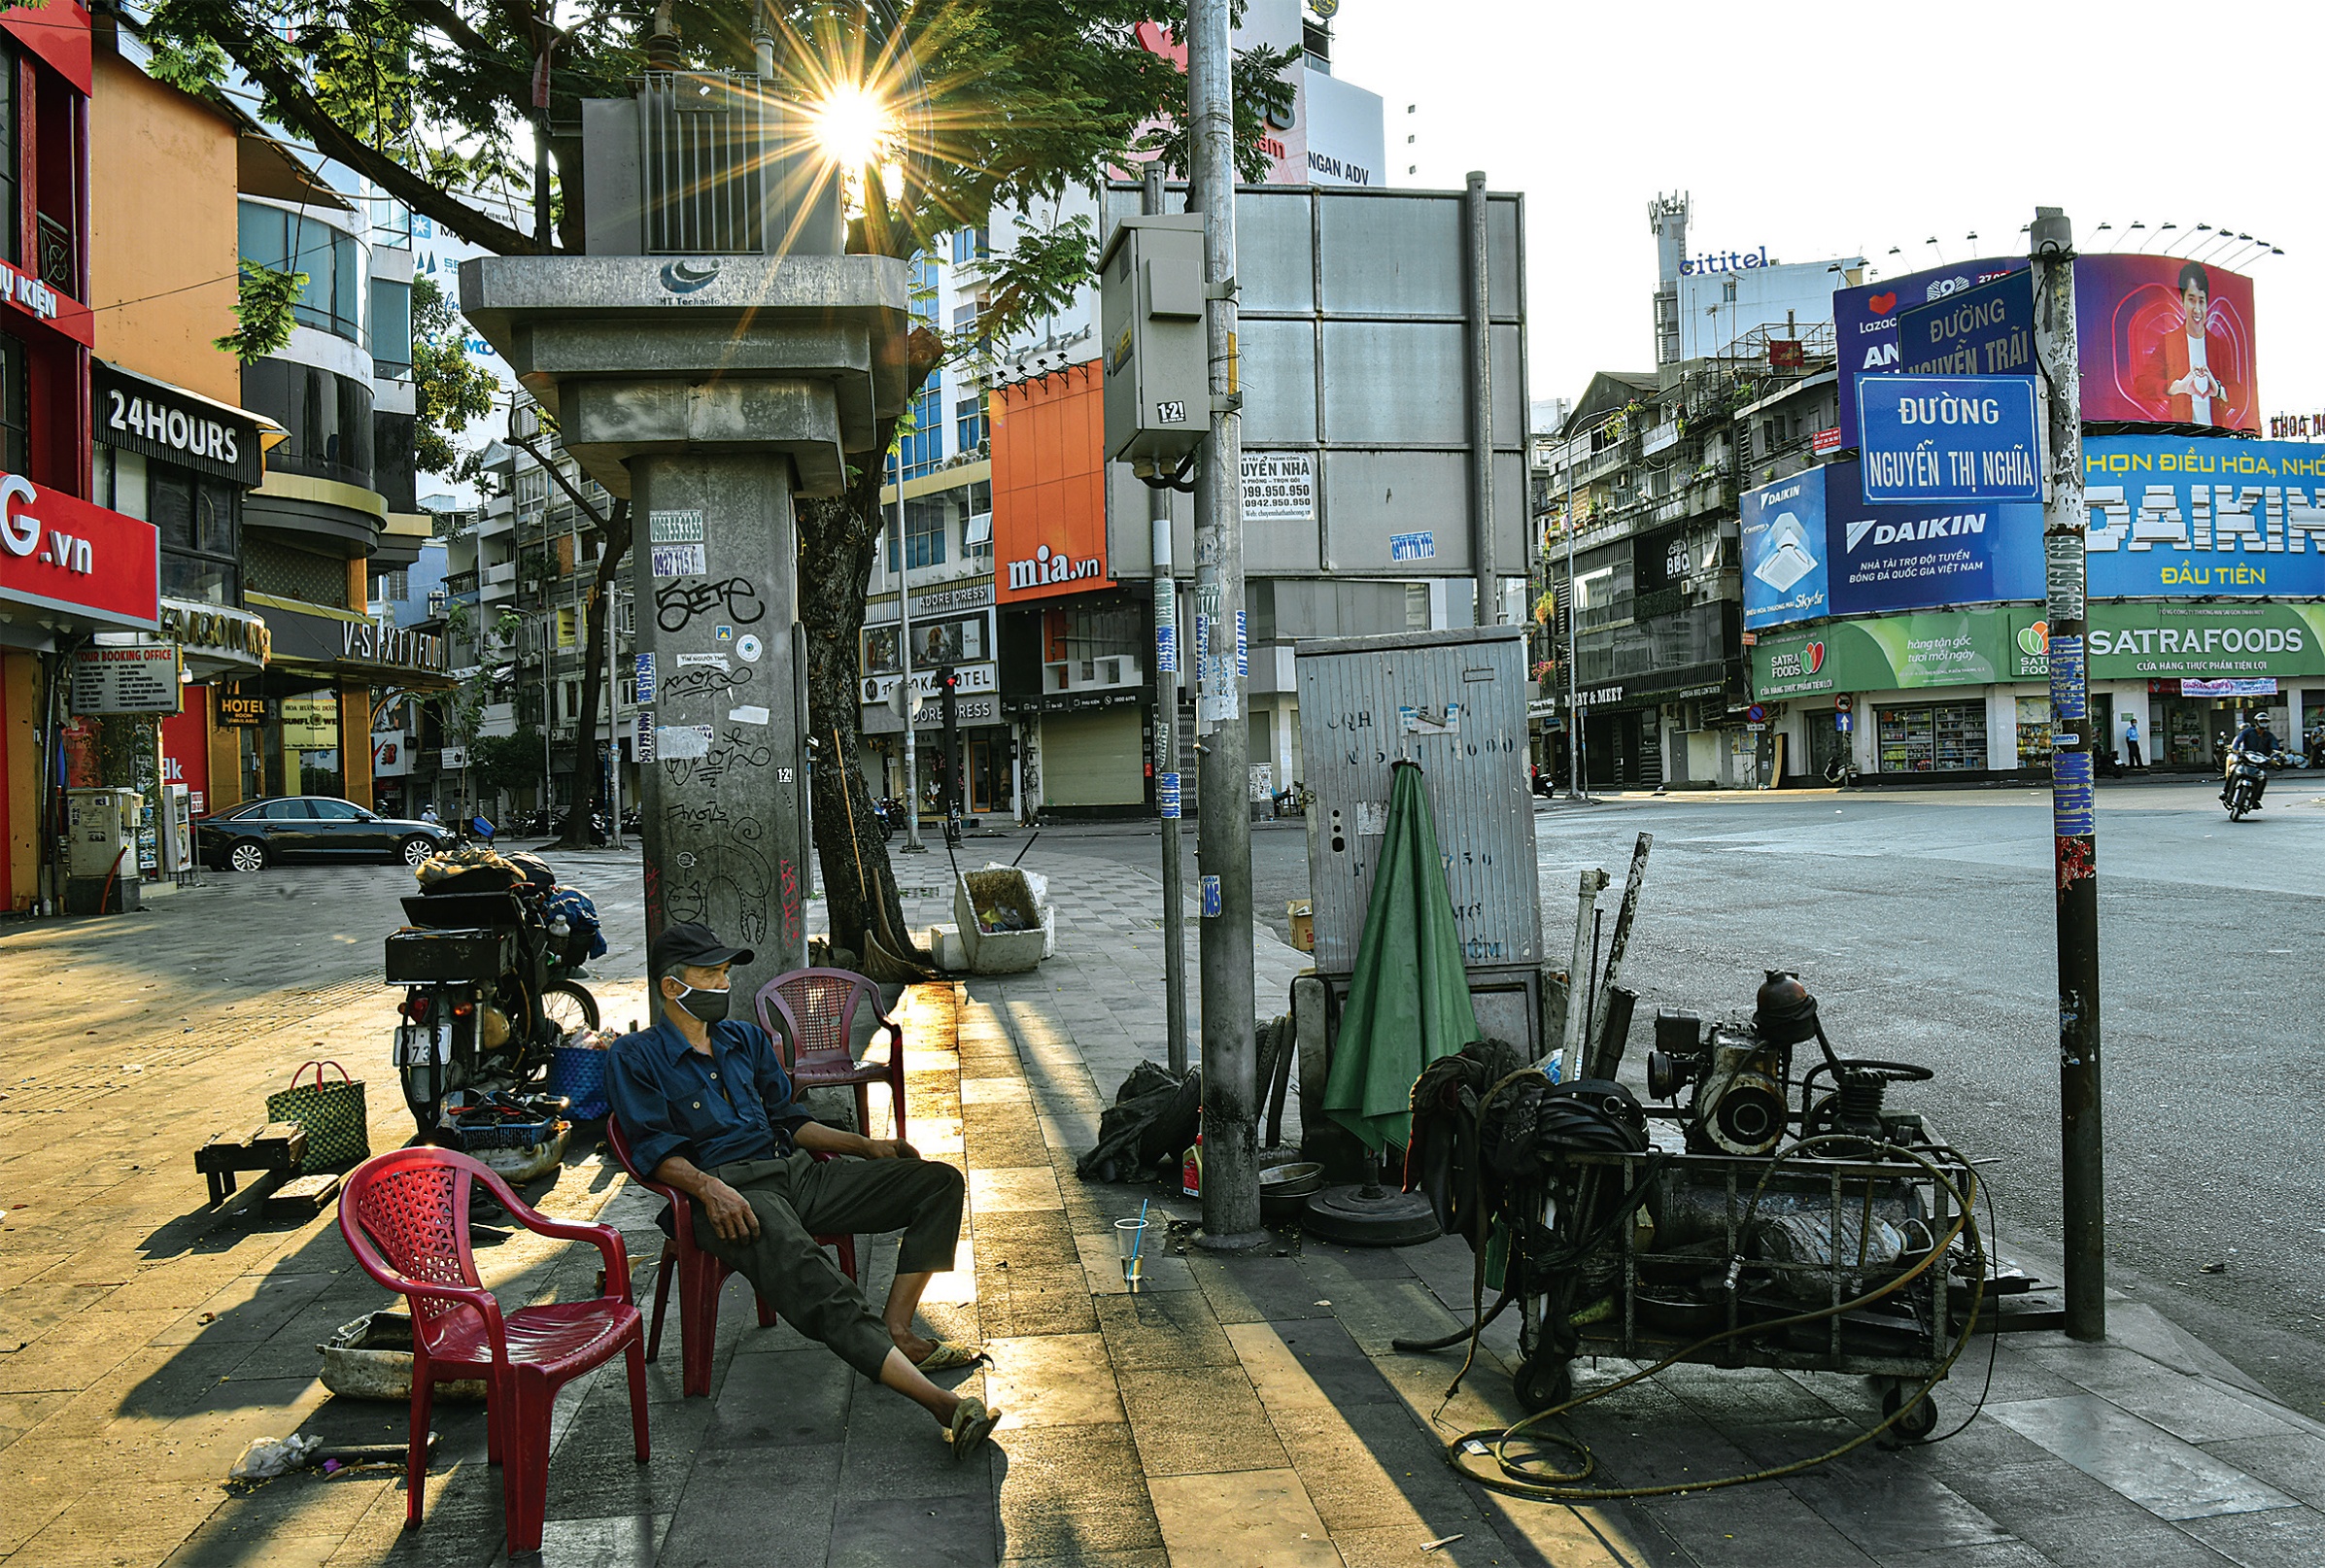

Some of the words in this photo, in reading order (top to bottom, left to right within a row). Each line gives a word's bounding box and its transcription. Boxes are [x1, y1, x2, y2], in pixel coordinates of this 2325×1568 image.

[1345, 163, 1369, 187] ADV
[1679, 246, 1768, 276] cititel
[0, 263, 14, 302] Ụ
[17, 275, 56, 320] KIỆN
[1931, 298, 2005, 343] ĐƯỜNG
[1863, 342, 1899, 369] AN
[1908, 339, 1977, 374] UYỄN
[1985, 325, 2029, 373] TRÃI
[1898, 392, 2000, 425] ĐƯỜNG
[108, 390, 239, 464] 24HOURS
[1241, 457, 1278, 477] UYỂN
[1282, 459, 1310, 476] NHÀ
[1869, 439, 1940, 488] NGUYỄN
[1948, 452, 1977, 493] THỊ
[1983, 444, 2034, 486] NGHĨA
[2086, 454, 2152, 477] HỌN
[2159, 447, 2215, 472] ĐIỀU
[2221, 451, 2277, 478] HÒA,
[1768, 485, 1800, 506] DAIKIN
[1873, 513, 1986, 546] DAIKIN
[1008, 545, 1099, 590] mia.vn
[1667, 554, 1691, 575] BBQ
[1861, 561, 1880, 571] NHÀ
[1883, 558, 1897, 569] TÀI
[1899, 556, 1920, 568] TRỢ
[1923, 553, 1936, 566] ĐỘI
[1938, 549, 1970, 562] TUYỂN
[1849, 569, 1875, 584] BÓNG
[1877, 568, 1890, 581] ĐÁ
[1892, 565, 1917, 580] QUỐC
[1920, 565, 1935, 576] GIA
[1937, 562, 1959, 576] VIỆT
[1960, 561, 1983, 572] NAM
[2161, 560, 2210, 585] ĐẦU
[2215, 562, 2266, 584] TIÊN
[920, 593, 950, 607] ADORE
[955, 586, 985, 602] DRESS
[161, 607, 242, 652] AIGON
[1907, 639, 1932, 650] hàng
[1934, 636, 1951, 648] tận
[1952, 634, 1972, 649] gốc
[2089, 628, 2303, 655] SATRAFOODS
[102, 650, 142, 662] BOOKING
[144, 649, 172, 661] OFFICE
[1771, 653, 1800, 666] SATRA
[1907, 652, 1928, 663] tươi
[1929, 649, 1948, 661] mỗi
[1949, 649, 1975, 662] ngày
[2137, 660, 2157, 671] CỬA
[2159, 661, 2184, 670] HÀNG
[2186, 661, 2207, 671] THỰC
[2209, 660, 2233, 670] PHẨM
[2234, 661, 2252, 672] TIỆN
[2254, 661, 2267, 671] LỢI
[912, 676, 940, 692] OKA
[955, 670, 990, 688] OTEL
[1772, 665, 1801, 678] FOODS
[2021, 666, 2049, 675] FOO
[1590, 695, 1596, 704] &
[1597, 686, 1623, 703] MEET
[222, 699, 265, 714] HOTEL
[913, 706, 943, 723] DORE
